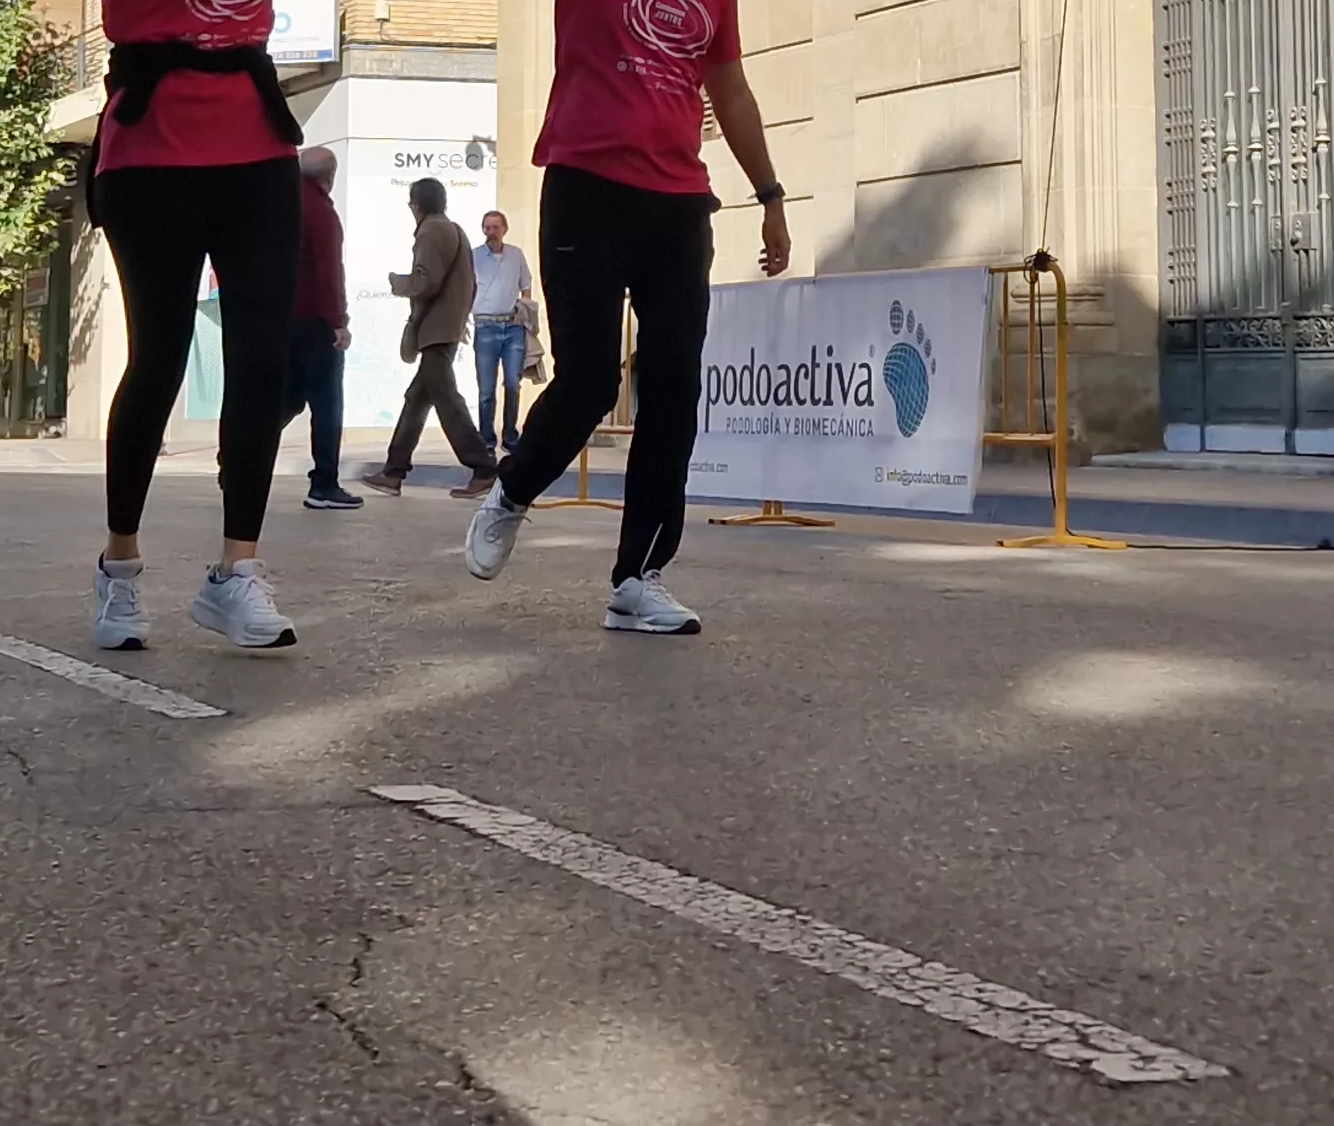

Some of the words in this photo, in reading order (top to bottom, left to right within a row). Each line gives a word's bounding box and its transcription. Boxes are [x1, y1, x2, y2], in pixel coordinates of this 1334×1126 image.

[394, 152, 435, 168] SMY
[704, 344, 875, 433] podoactiva
[726, 411, 781, 435] PODOLOGÍA
[784, 419, 791, 434] Y
[793, 412, 874, 438] BIOMECÁNICA
